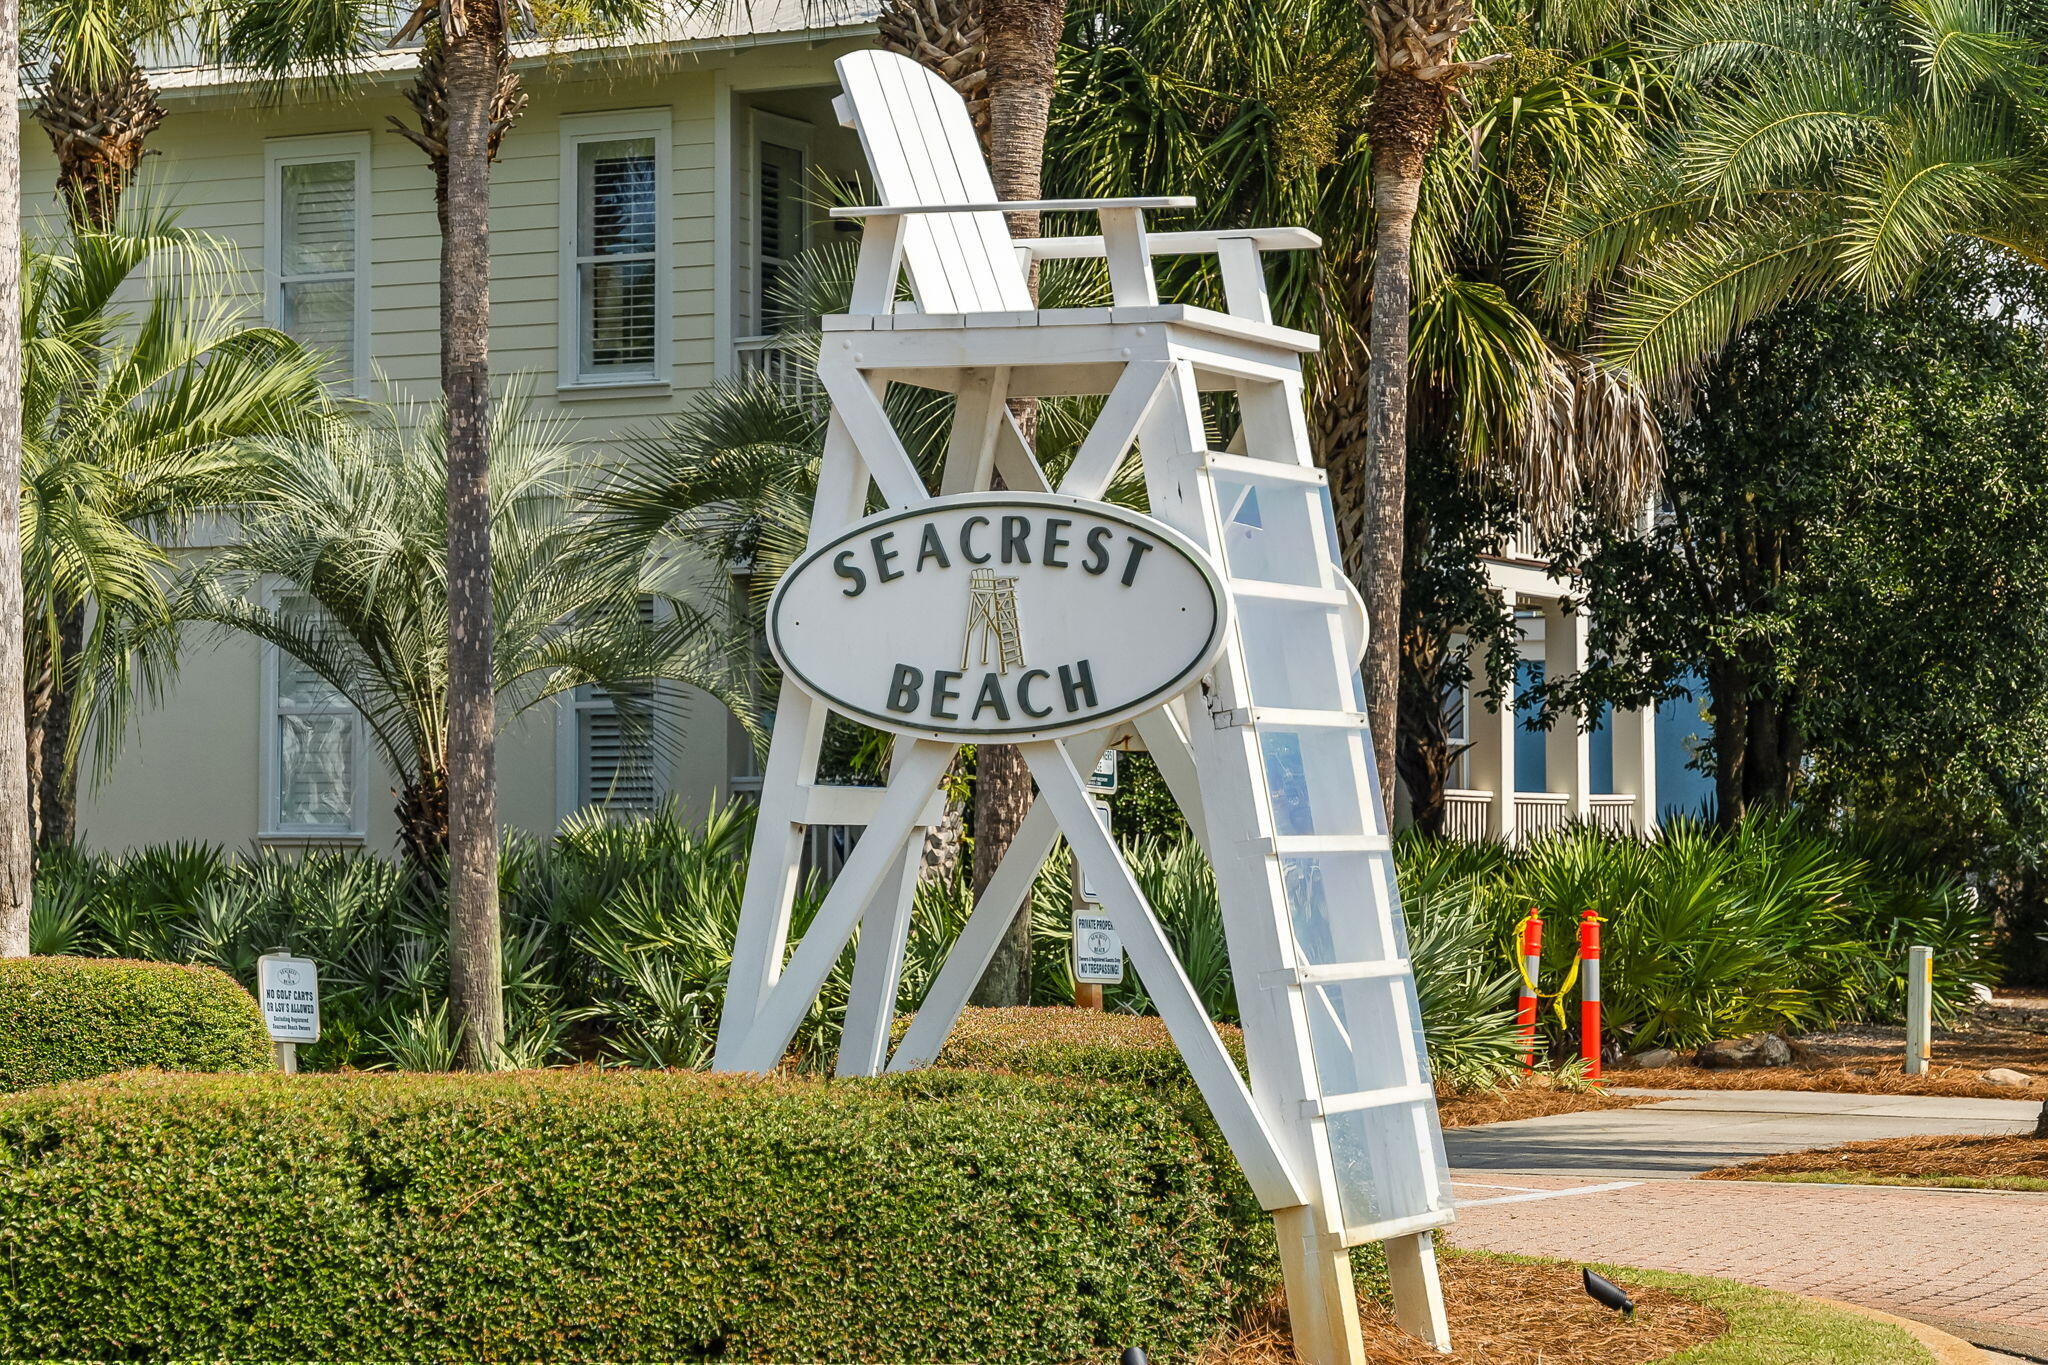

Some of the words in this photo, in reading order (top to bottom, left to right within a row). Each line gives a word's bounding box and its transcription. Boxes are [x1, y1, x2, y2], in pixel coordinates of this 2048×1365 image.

[833, 515, 1154, 597] SEACREST
[886, 659, 1098, 721] BEACH
[1079, 919, 1096, 929] PRIVATE
[1081, 964, 1087, 973] NO
[1088, 964, 1119, 975] TRESPASSING!
[266, 989, 274, 998] NO
[276, 989, 292, 1001] GOLF
[294, 991, 313, 1001] CARTS
[267, 1002, 273, 1011] OR
[291, 1004, 314, 1014] ALLOWED
